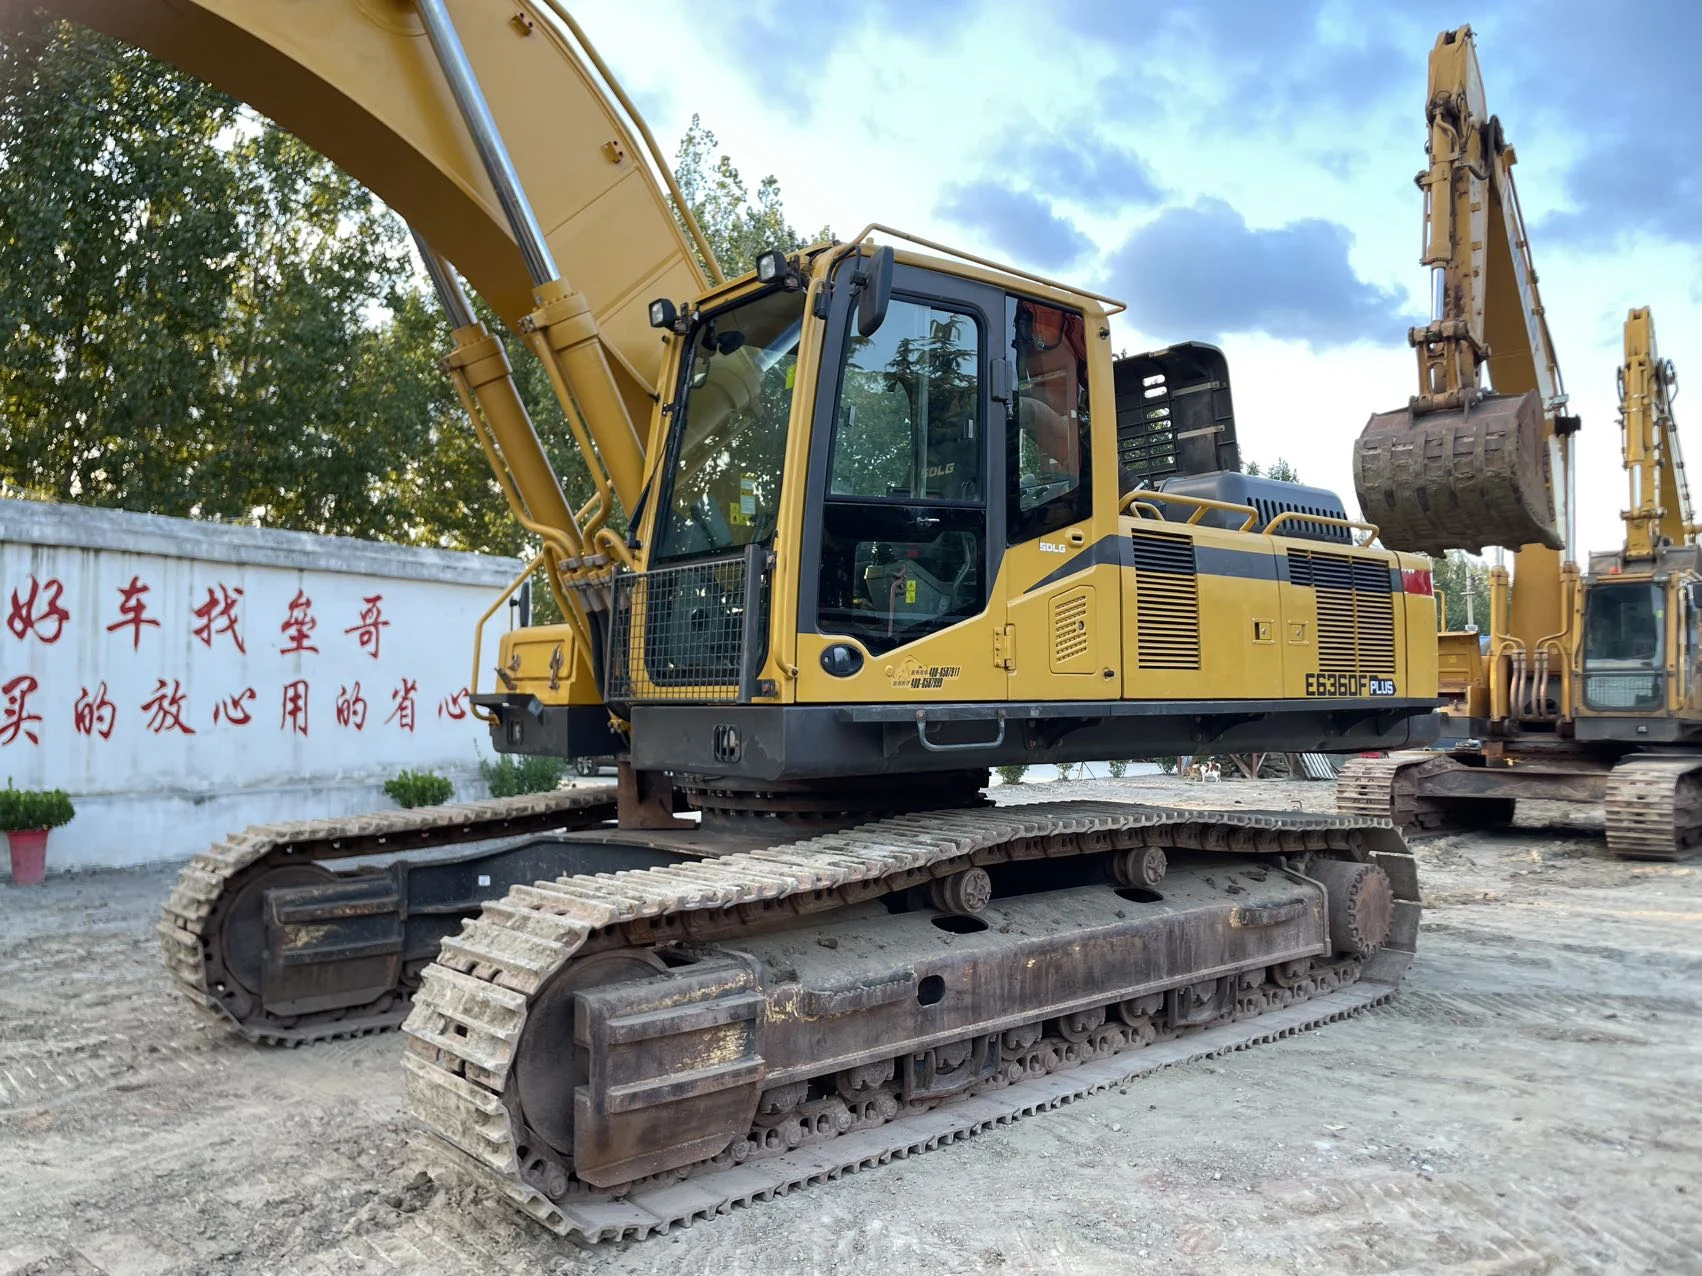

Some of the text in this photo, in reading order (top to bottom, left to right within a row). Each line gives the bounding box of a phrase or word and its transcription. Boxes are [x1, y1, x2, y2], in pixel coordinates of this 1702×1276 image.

[1039, 542, 1066, 553] SDLG
[6, 575, 391, 660] 好车找垒哥
[1305, 673, 1394, 696] E6360F PLUS
[0, 674, 470, 746] 买的放心用的省心
